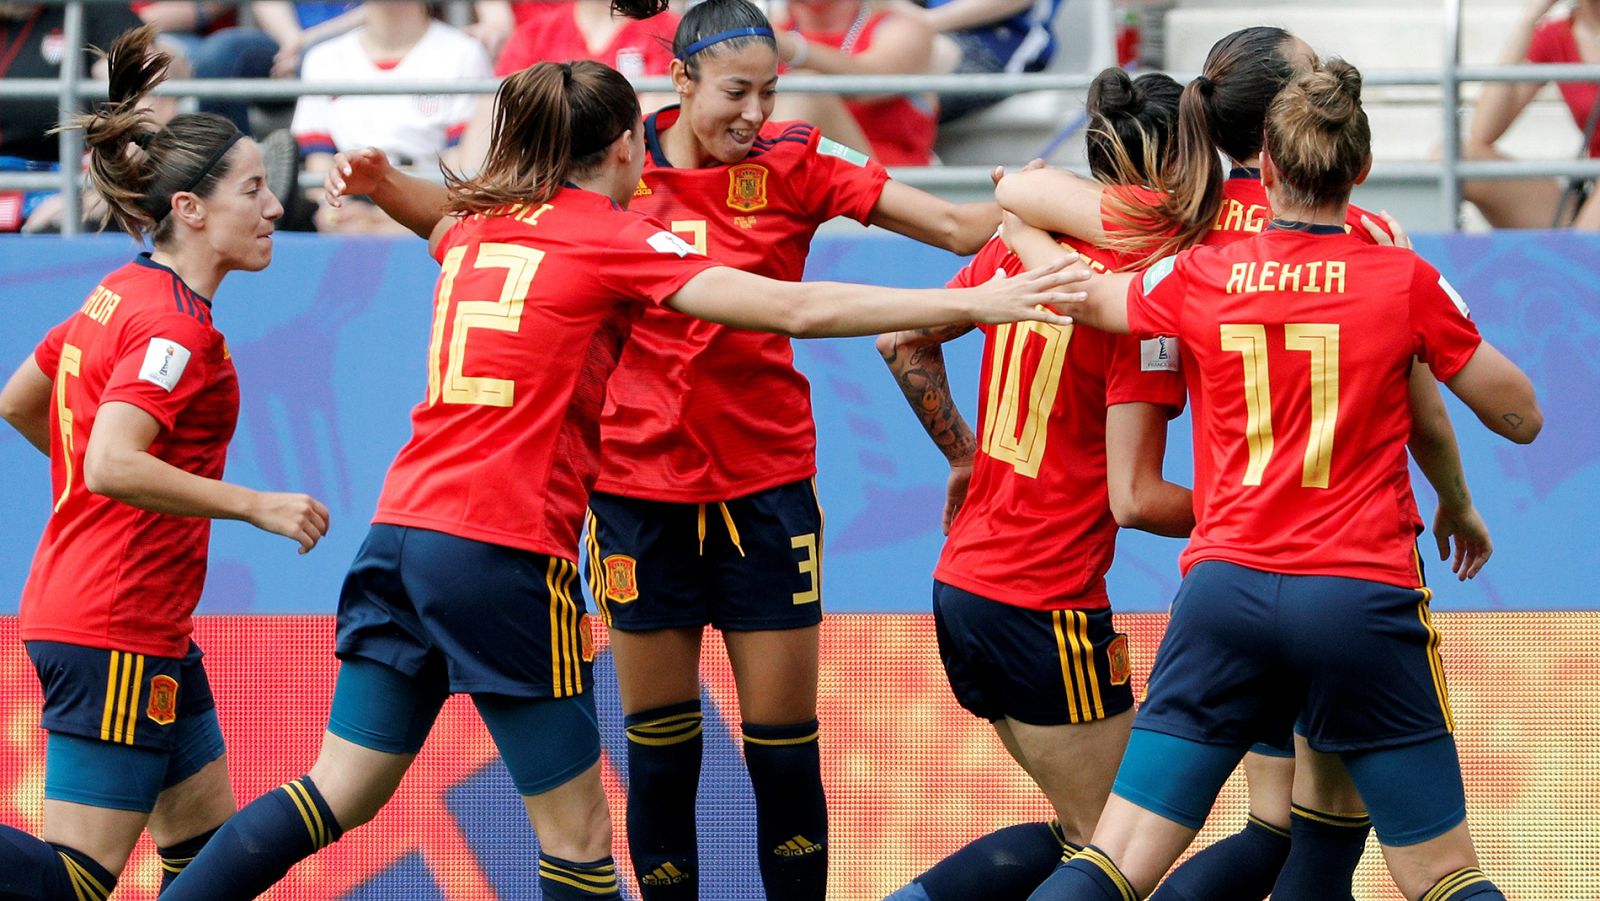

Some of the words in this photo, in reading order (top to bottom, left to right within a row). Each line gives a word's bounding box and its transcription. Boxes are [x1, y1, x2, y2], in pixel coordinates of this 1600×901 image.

[428, 242, 546, 407] 12
[982, 304, 1073, 479] 10
[1220, 323, 1340, 489] 11
[790, 532, 819, 606] 3
[642, 872, 690, 886] adidas
[773, 843, 822, 857] adidas
